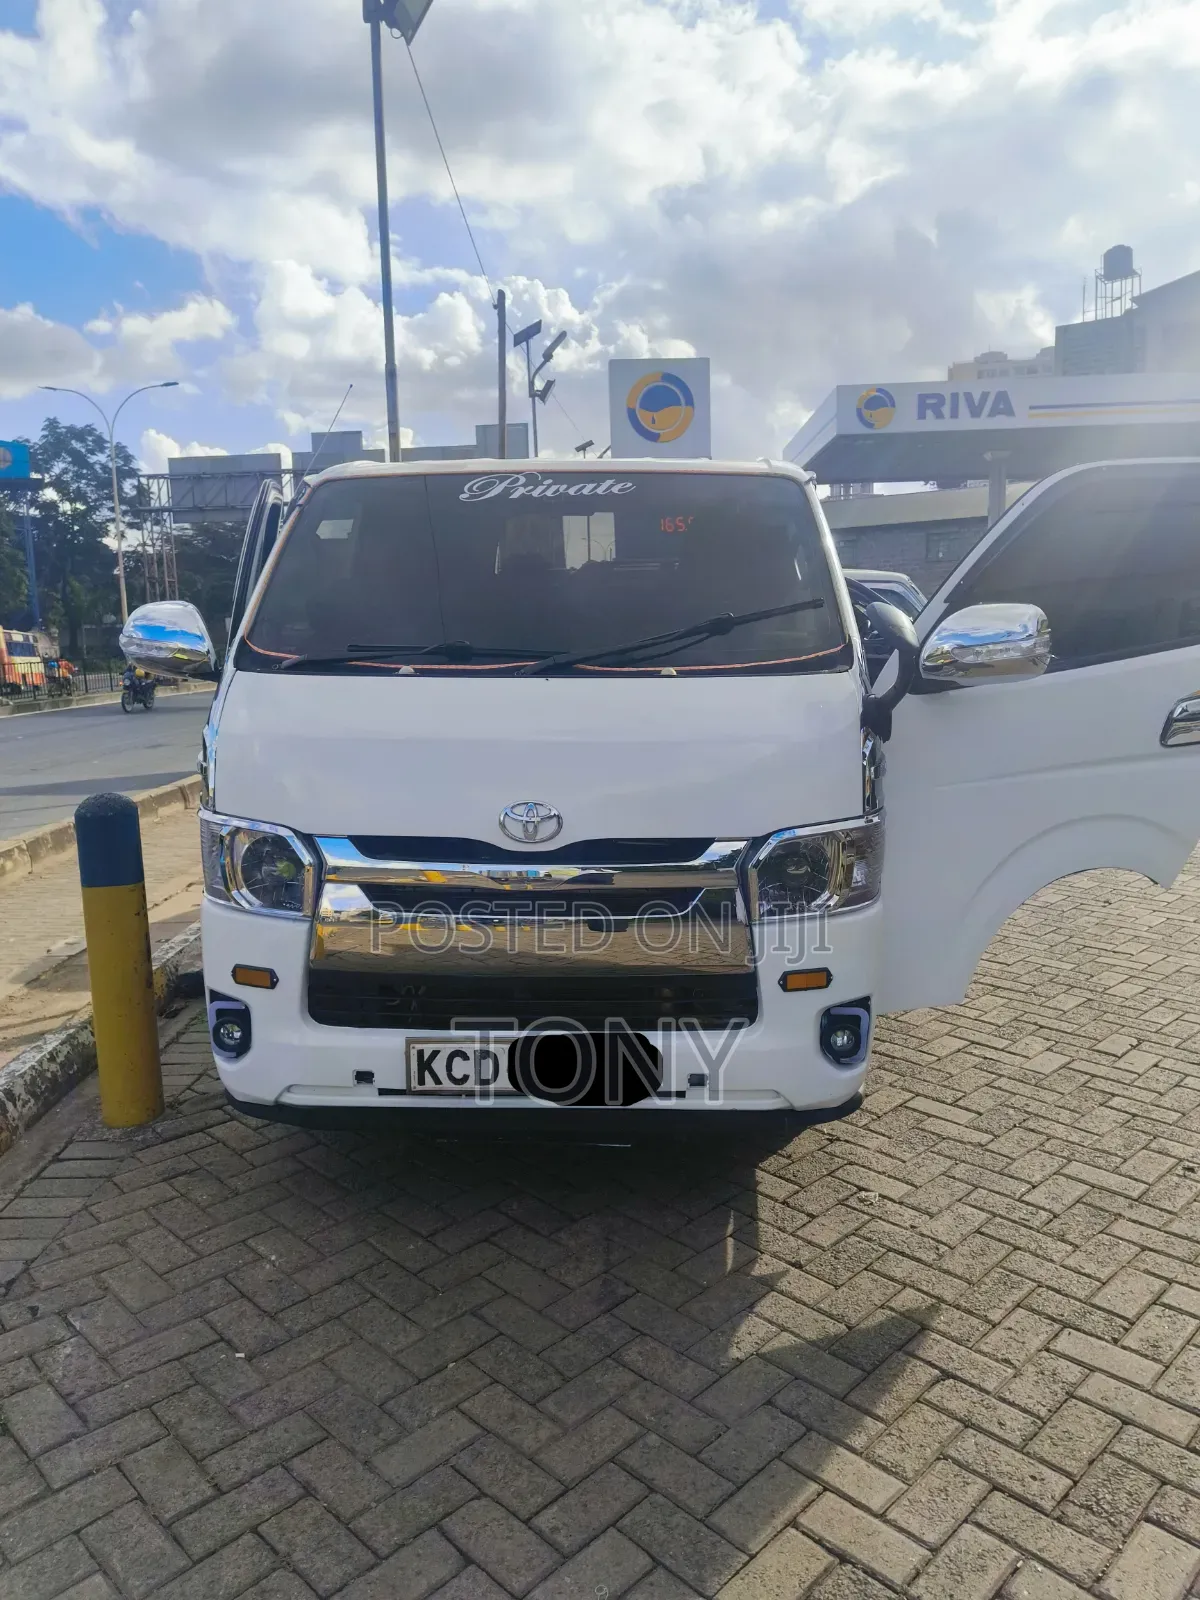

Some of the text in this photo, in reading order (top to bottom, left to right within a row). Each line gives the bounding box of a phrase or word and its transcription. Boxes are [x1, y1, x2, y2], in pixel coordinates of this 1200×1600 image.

[916, 390, 1016, 420] RIVA
[458, 472, 636, 502] Private
[415, 1049, 500, 1087] KCD
